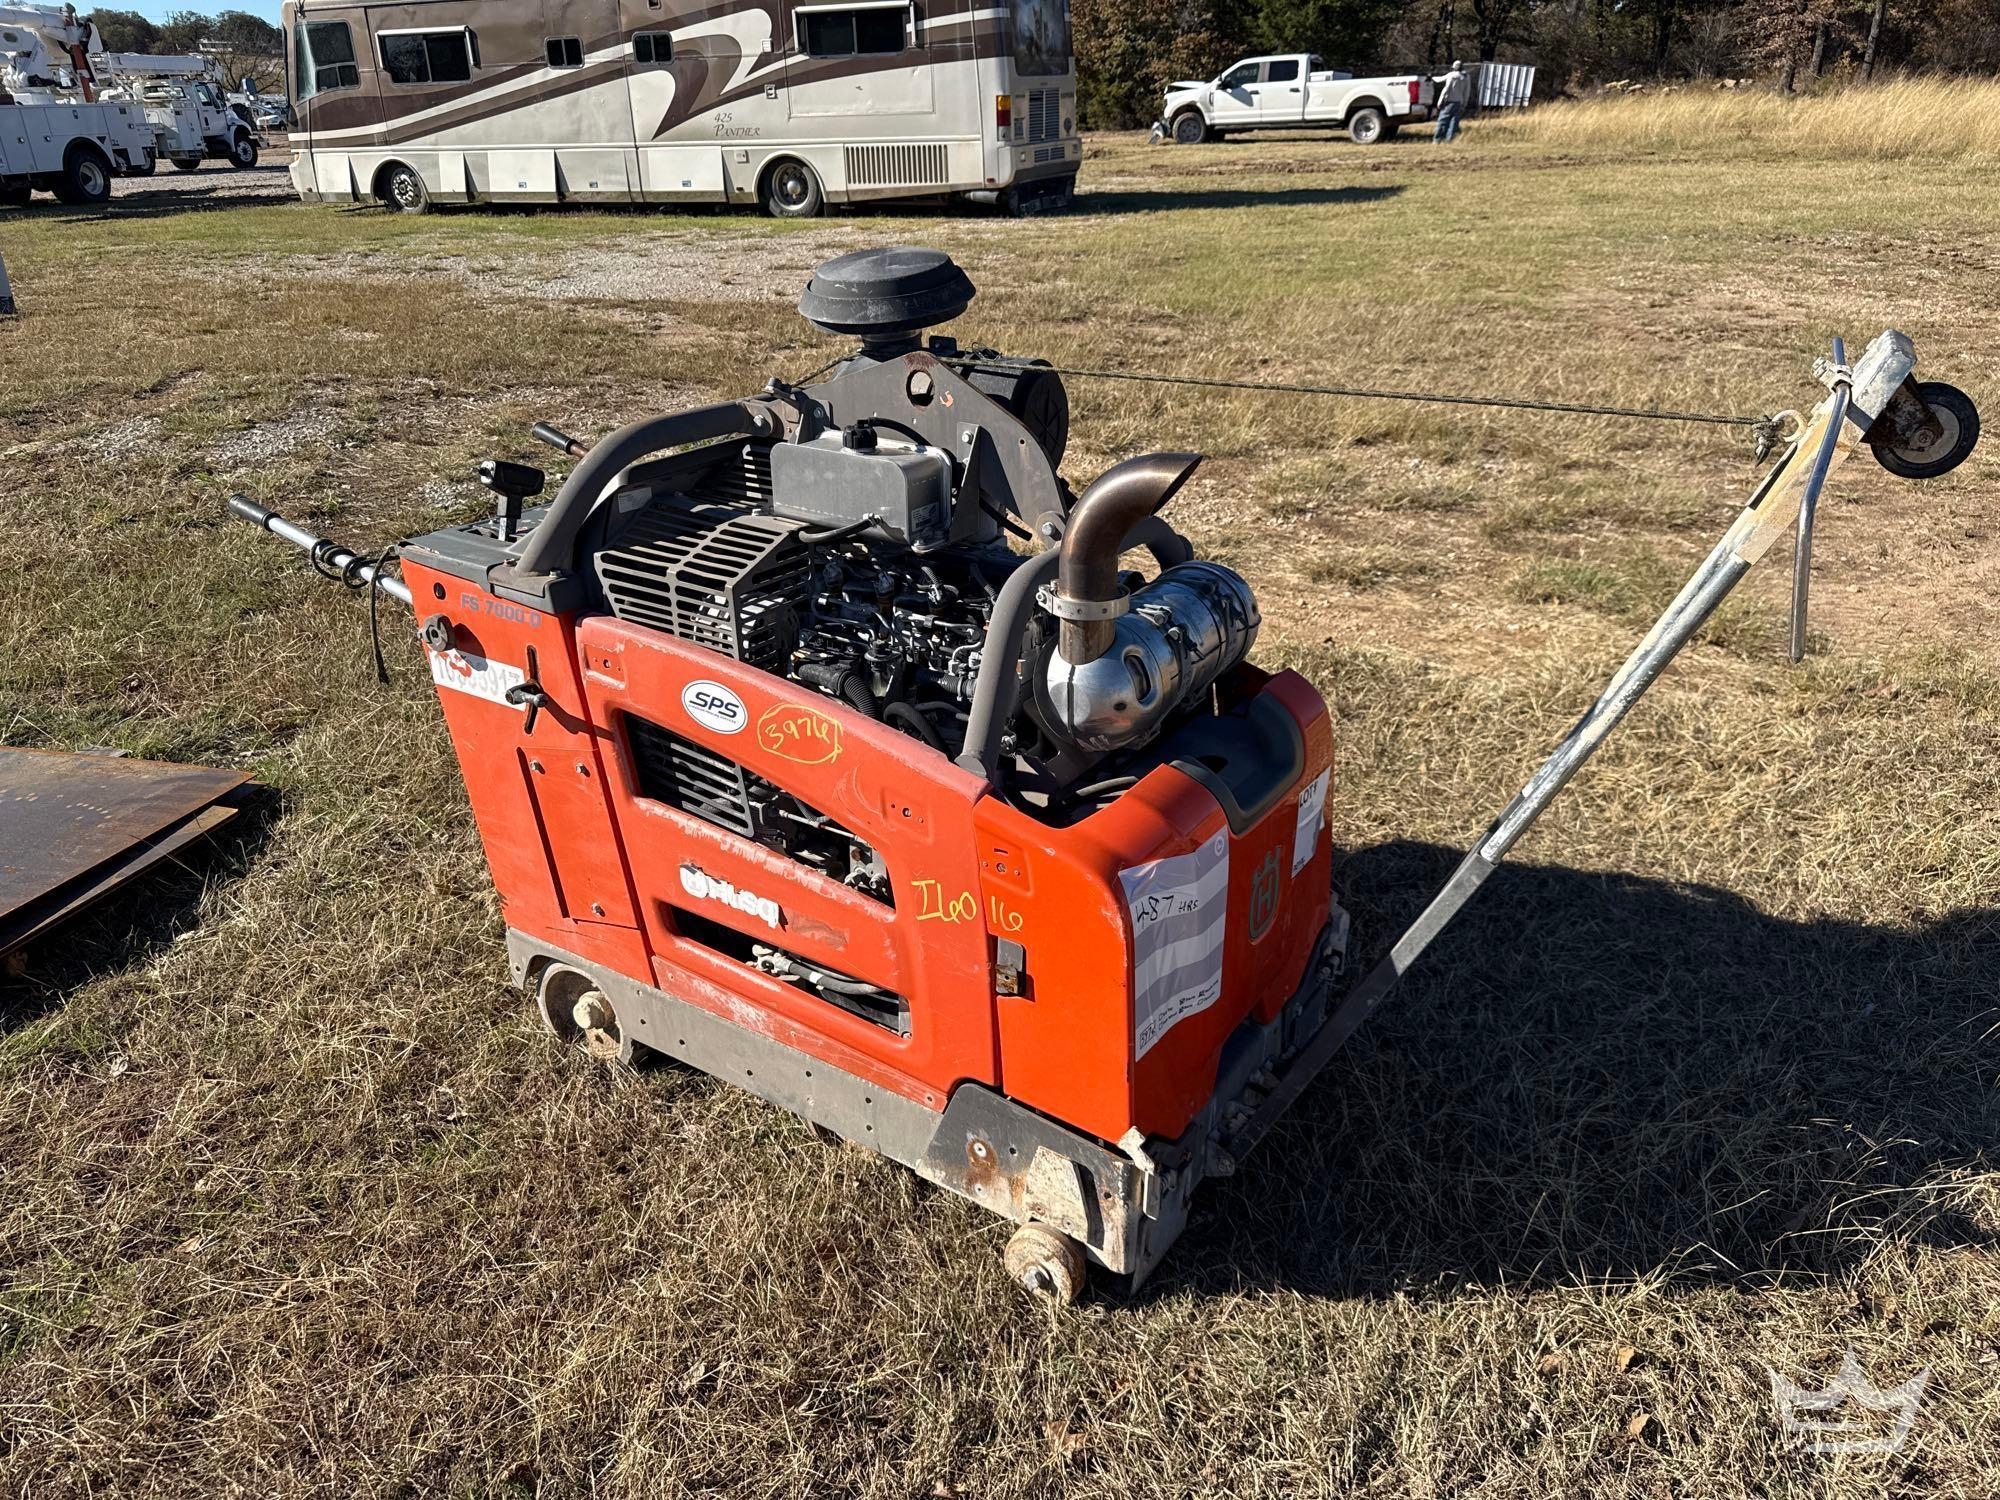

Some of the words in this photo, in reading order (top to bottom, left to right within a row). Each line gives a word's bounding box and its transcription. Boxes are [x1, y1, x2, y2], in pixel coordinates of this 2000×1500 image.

[714, 112, 732, 123] 425
[460, 593, 480, 612] FS
[485, 599, 525, 623] 7000
[690, 691, 740, 719] SPS
[764, 715, 831, 750] 3976
[1135, 894, 1175, 930] 487
[1178, 899, 1199, 914] HRS
